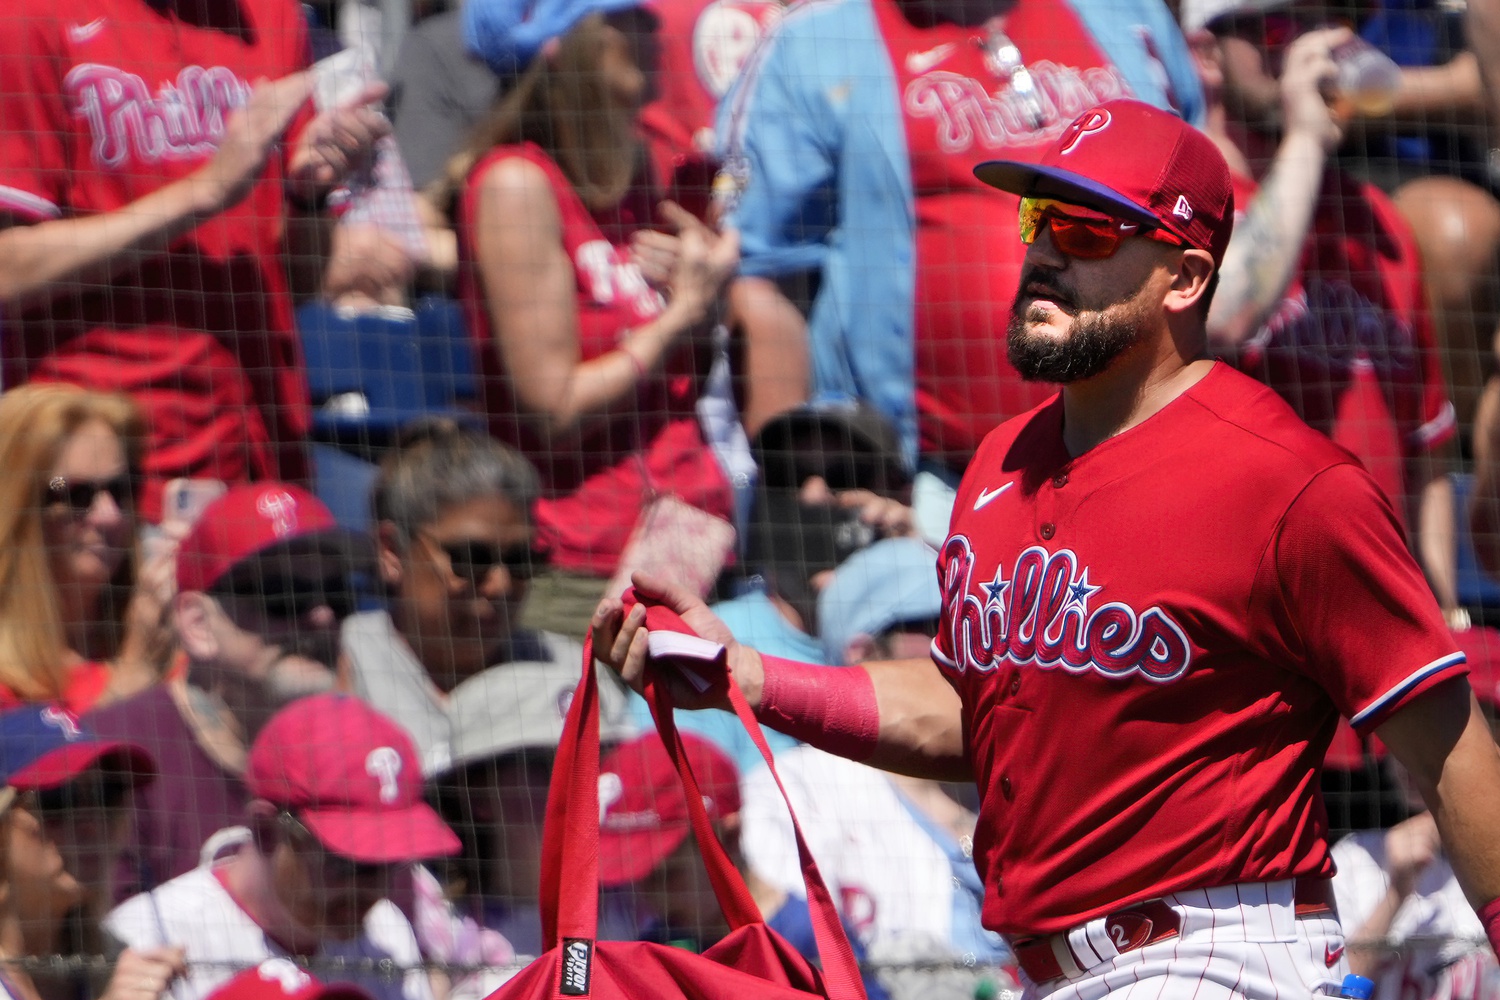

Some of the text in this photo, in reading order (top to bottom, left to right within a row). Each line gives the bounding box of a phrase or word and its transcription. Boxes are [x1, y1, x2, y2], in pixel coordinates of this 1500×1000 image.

[64, 62, 253, 168] Phill
[1060, 107, 1112, 156] P
[1111, 924, 1130, 948] 2
[570, 942, 589, 992] Pryor
